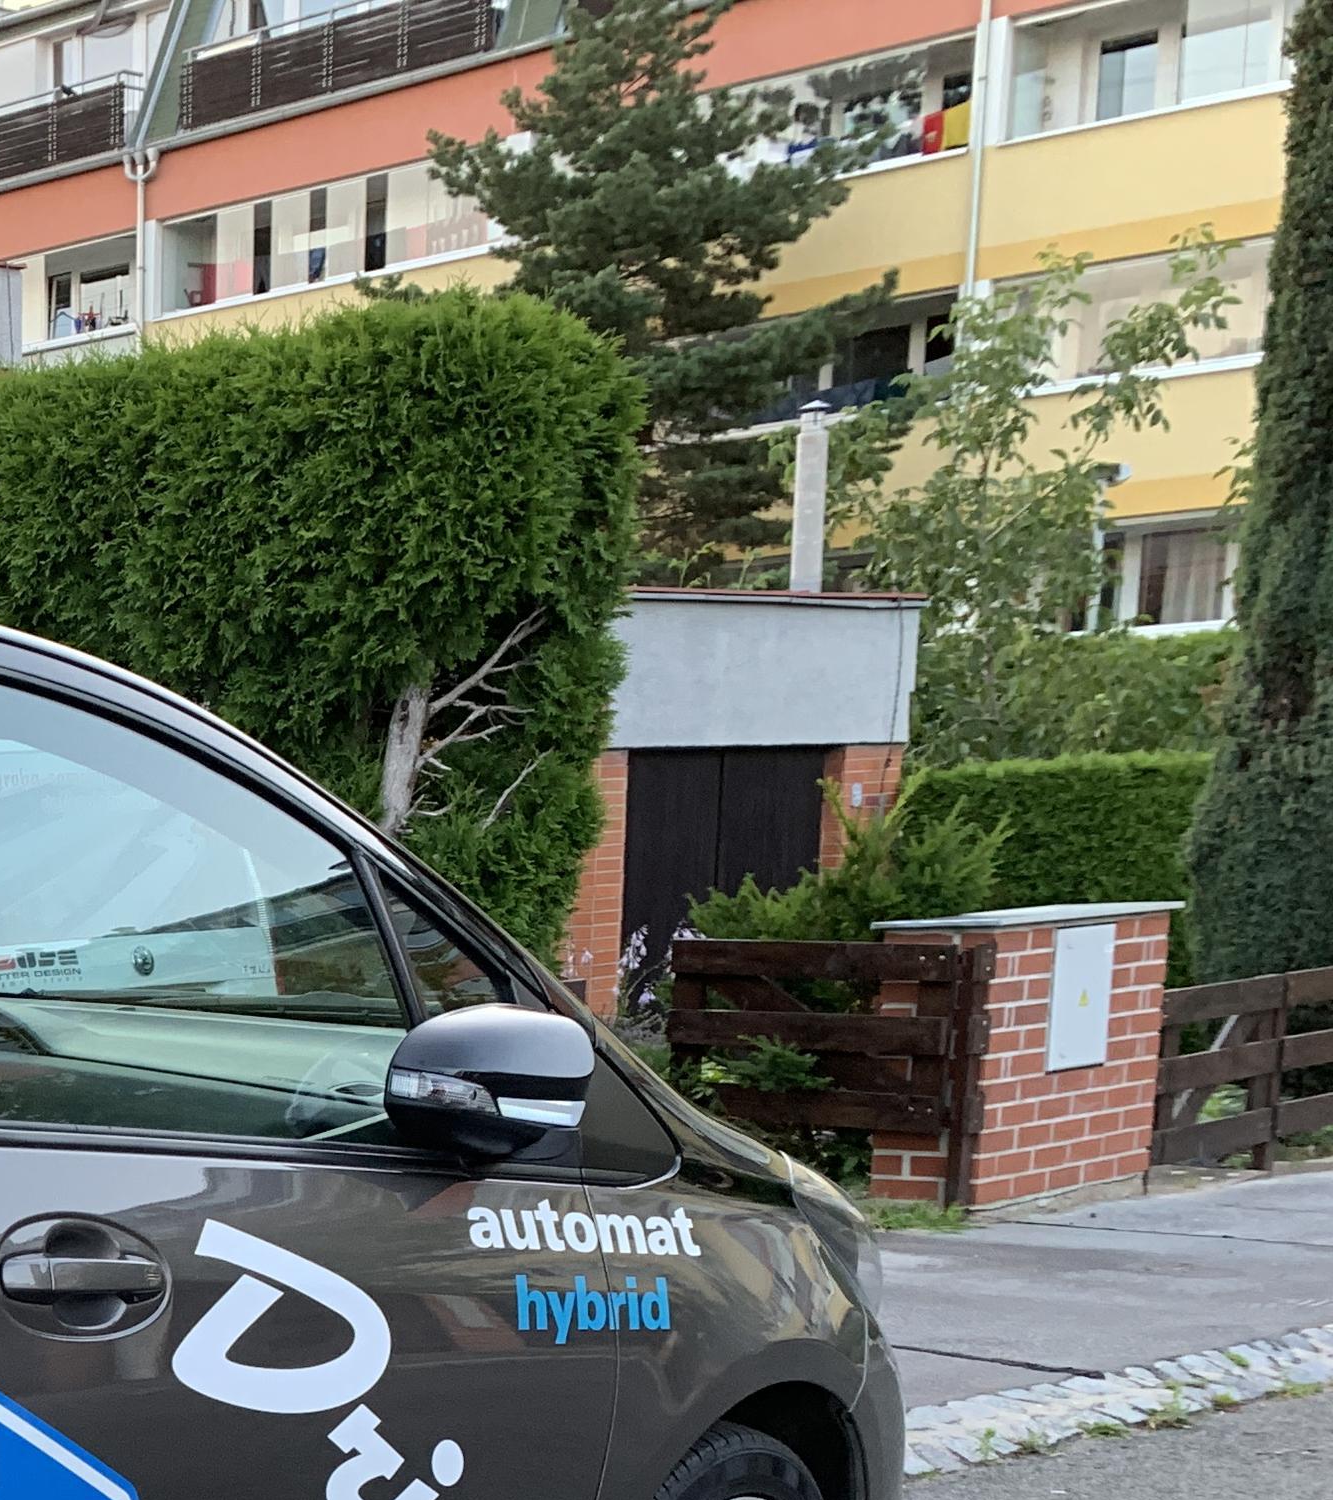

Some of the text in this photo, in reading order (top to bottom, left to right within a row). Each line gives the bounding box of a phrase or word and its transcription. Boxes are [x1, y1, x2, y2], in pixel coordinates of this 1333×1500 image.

[33, 967, 82, 977] DESIGN
[467, 1199, 701, 1257] automat
[516, 1274, 671, 1344] hybrid
